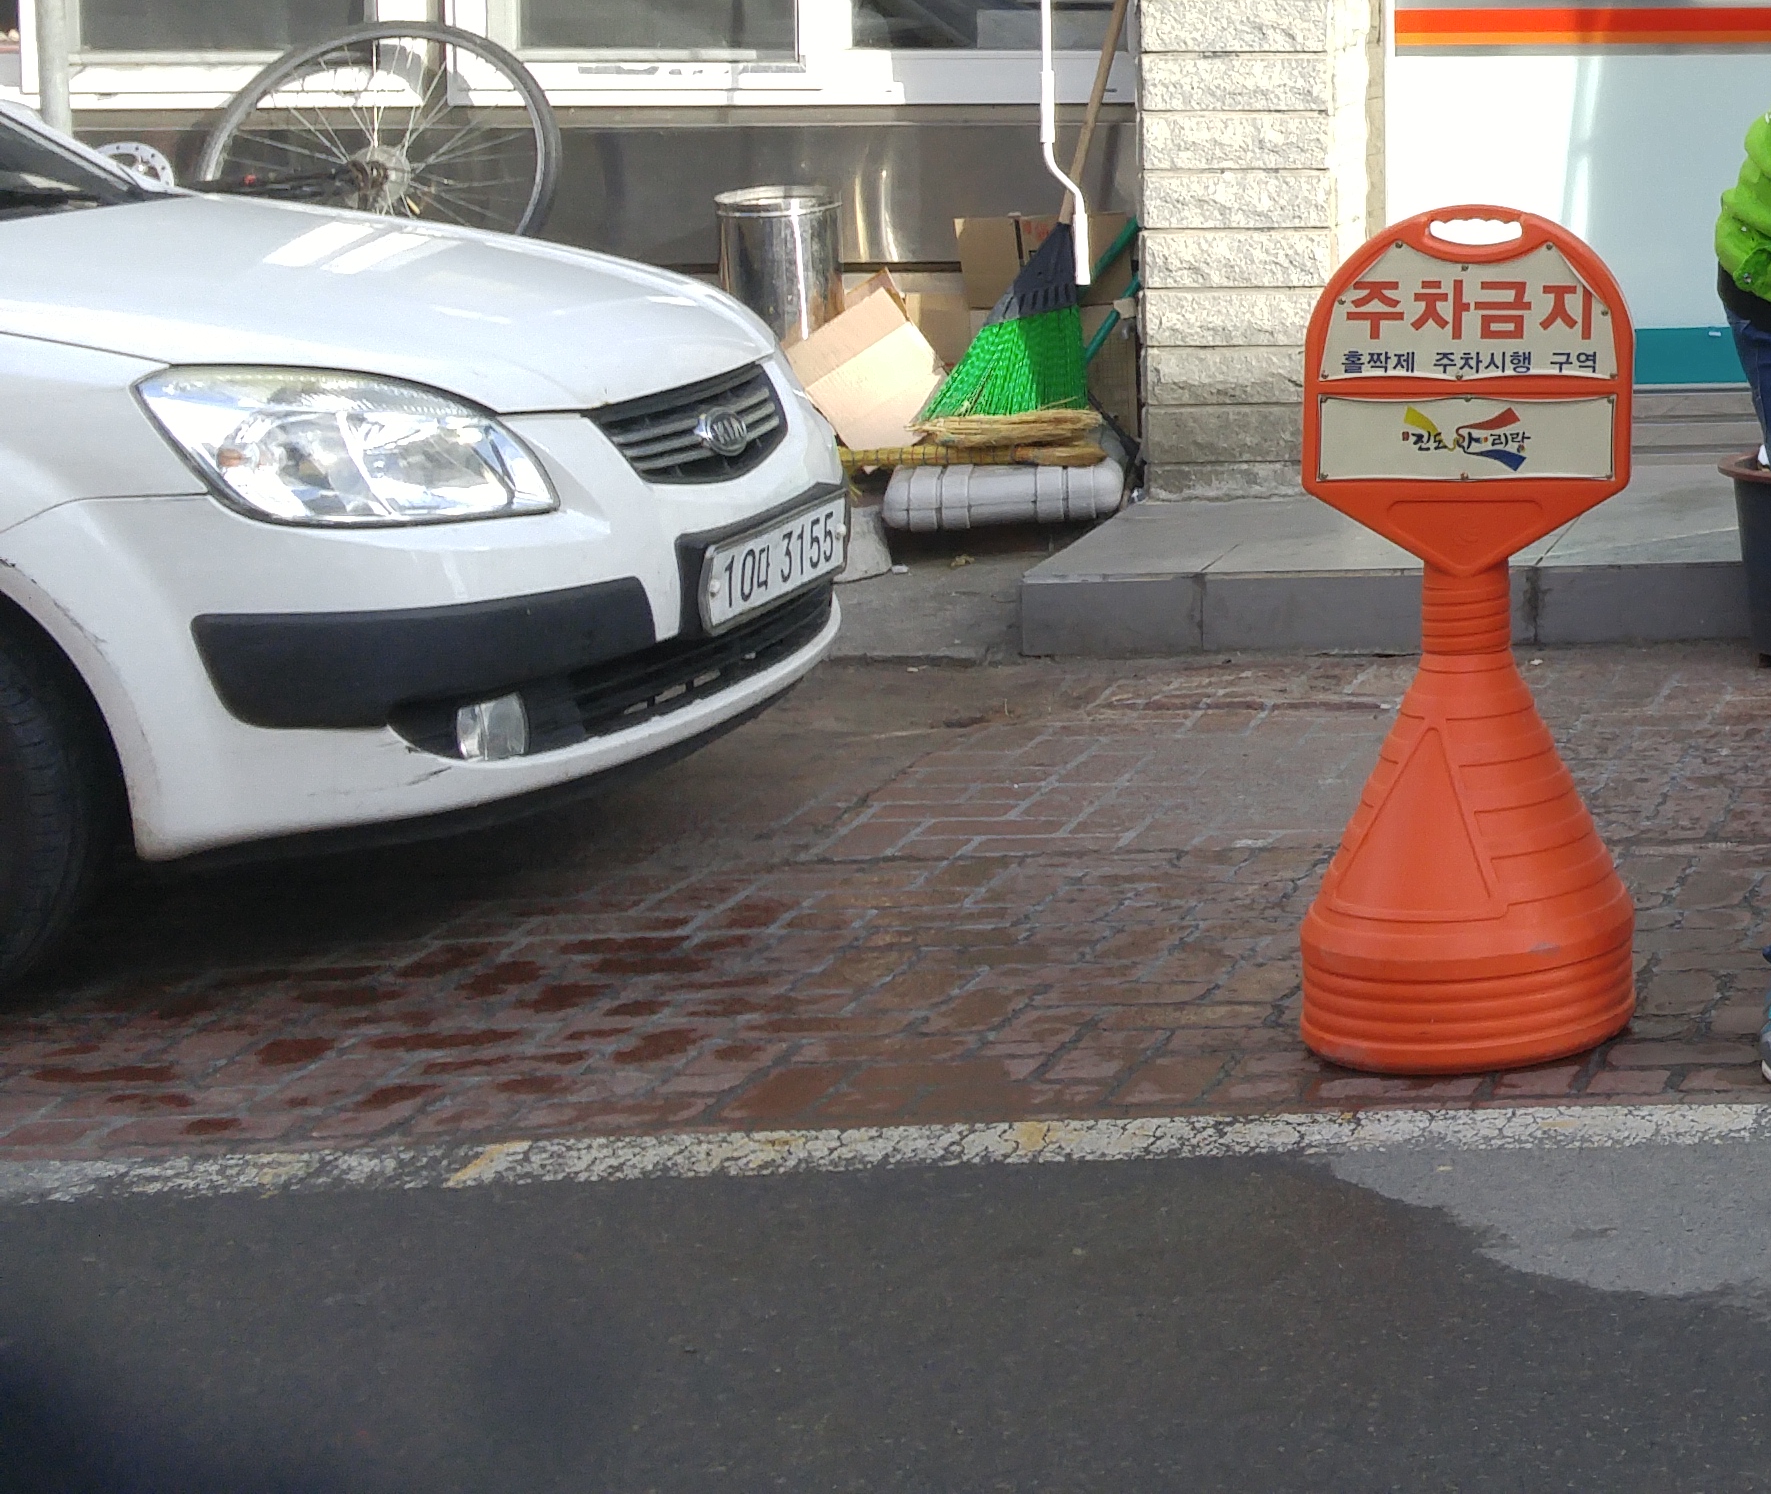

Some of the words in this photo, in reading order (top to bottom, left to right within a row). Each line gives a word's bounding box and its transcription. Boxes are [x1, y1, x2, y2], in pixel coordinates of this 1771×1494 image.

[1344, 278, 1593, 341] 주차금지
[1341, 350, 1416, 374] 홀짝제
[1432, 350, 1533, 374] 주차시행
[1549, 350, 1597, 374] 구역
[780, 510, 834, 584] 3155
